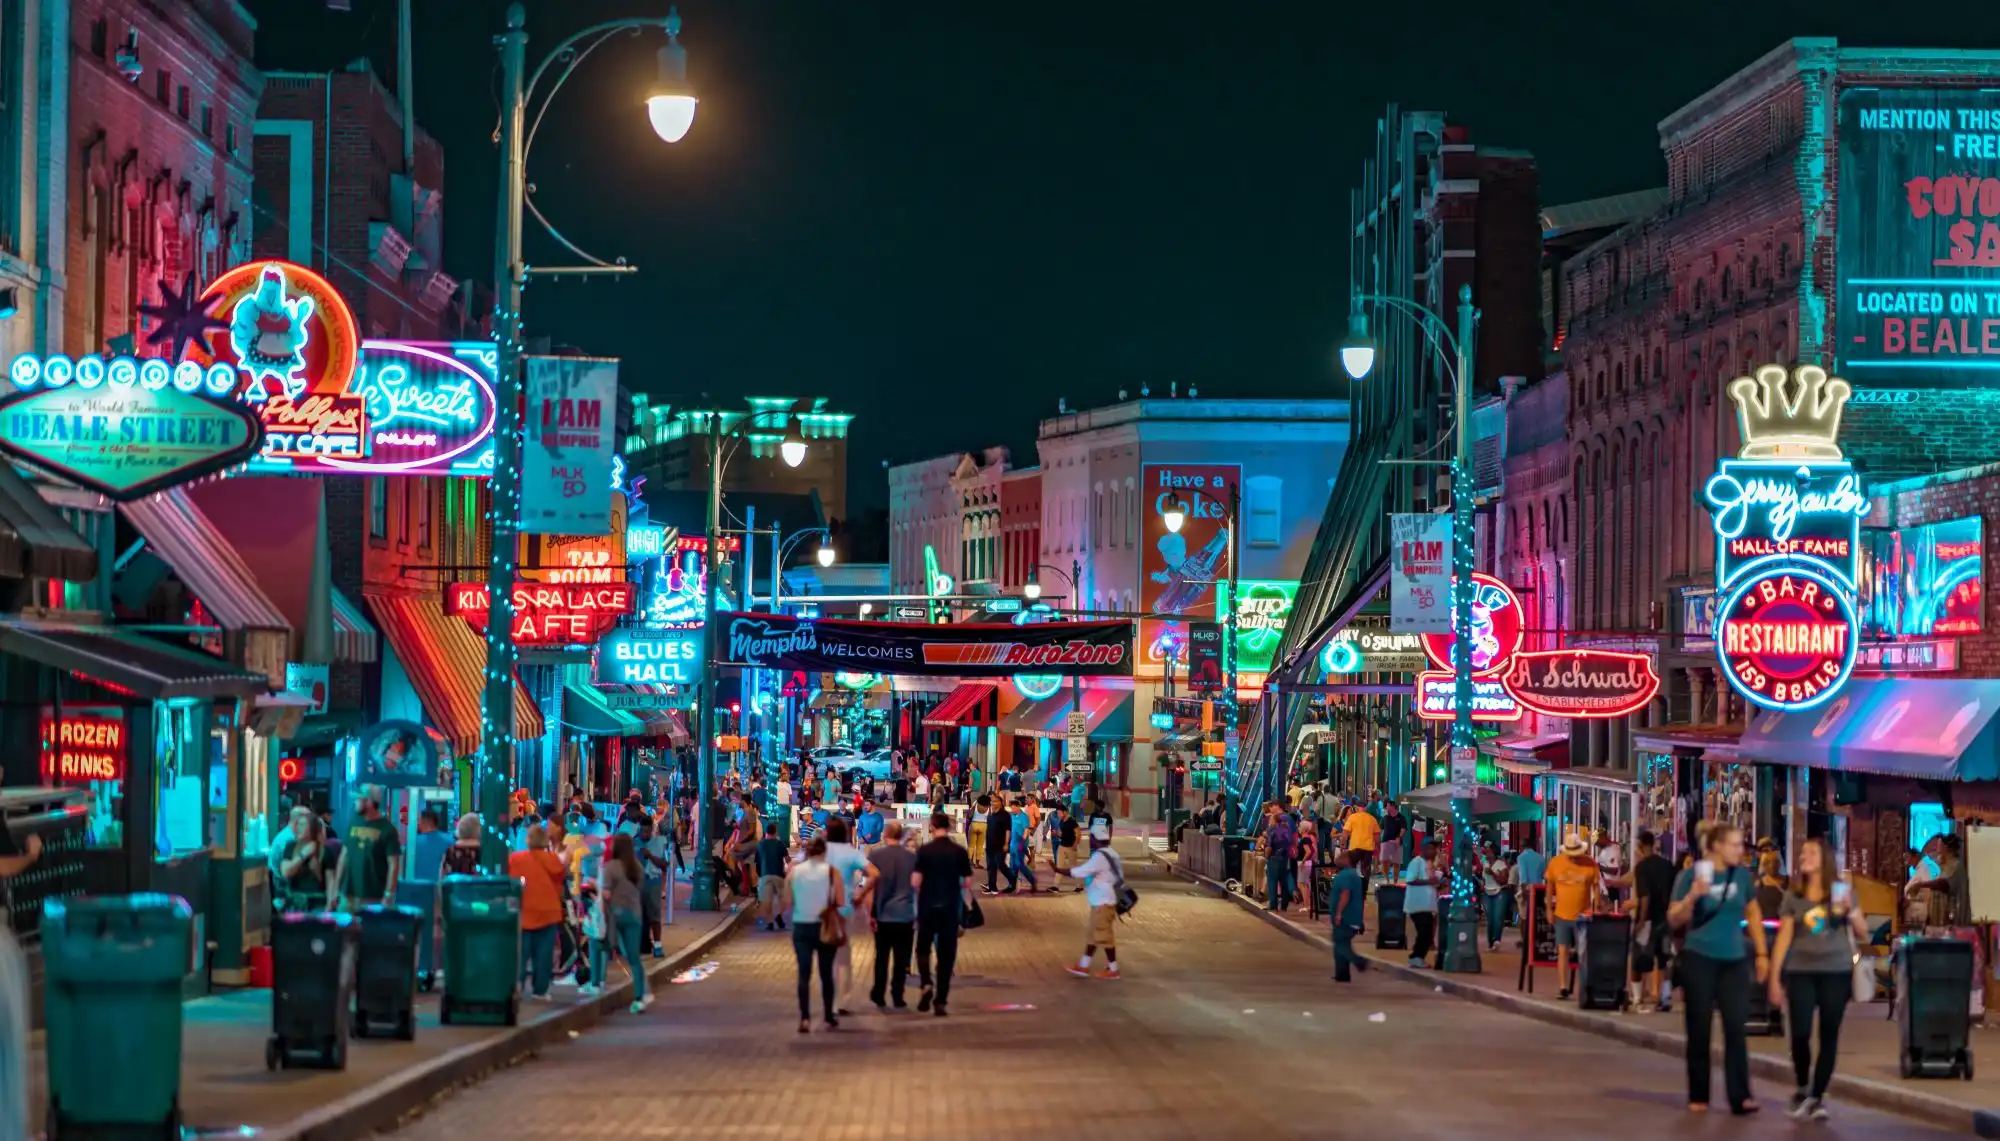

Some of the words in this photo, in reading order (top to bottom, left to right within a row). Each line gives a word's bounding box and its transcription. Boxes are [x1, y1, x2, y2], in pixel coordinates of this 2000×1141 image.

[1860, 109, 1950, 129] MENTION
[1957, 109, 2000, 129] THIS
[1954, 134, 2000, 158] FRE
[1857, 292, 1944, 312] LOCATED
[1950, 292, 1978, 312] ON
[1984, 292, 2000, 312] T
[1884, 317, 2000, 353] BEALE
[542, 399, 551, 427] I
[557, 399, 600, 428] AM
[11, 414, 108, 442] BEALE
[119, 415, 236, 446] STREET
[542, 433, 600, 448] MEMPHIS
[551, 465, 584, 480] MLK
[1160, 470, 1204, 488] Have
[1211, 476, 1224, 488] a
[563, 480, 587, 498] 50
[1402, 541, 1409, 562] I
[1414, 541, 1443, 562] AM
[1732, 540, 1775, 555] HALL
[1777, 540, 1799, 555] OF
[1804, 540, 1849, 555] FAME
[567, 551, 610, 567] TAP
[1403, 566, 1443, 575] MEMPHIS
[1410, 587, 1433, 597] MLK
[1759, 575, 1818, 606] BAR
[537, 591, 626, 610] PALACE
[1418, 597, 1435, 609] 50
[512, 616, 586, 638] AFE
[1726, 622, 1847, 654] RESTAURANT
[616, 641, 698, 660] BLUES
[729, 632, 817, 664] Memphis
[820, 643, 914, 660] WELCOMES
[1004, 640, 1125, 665] AutoZone
[625, 663, 689, 682] HALL
[1512, 659, 1539, 688] A.
[1543, 657, 1650, 689] Schwab
[1735, 660, 1766, 690] 159
[1774, 660, 1841, 701] BEALE
[615, 696, 643, 707] JUKE
[651, 696, 684, 707] JOINT
[1536, 695, 1605, 708] ESTABLISHED
[1069, 724, 1085, 733] 25
